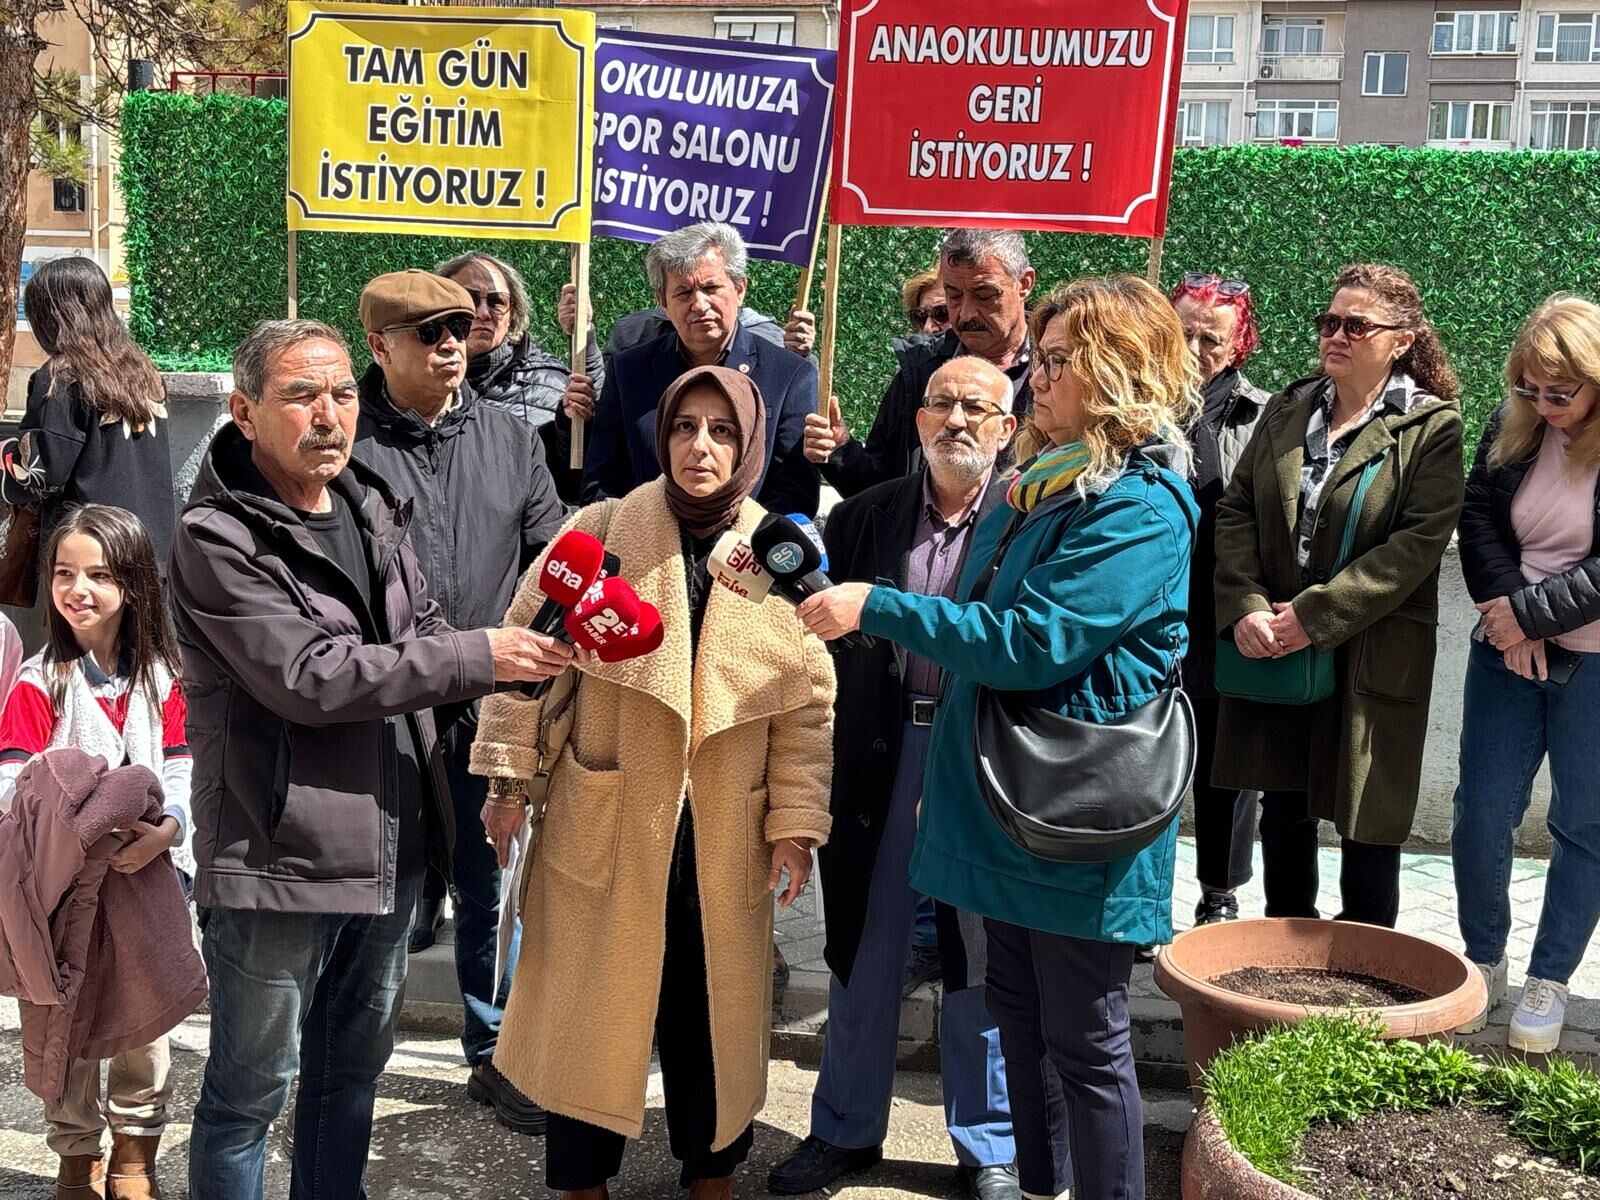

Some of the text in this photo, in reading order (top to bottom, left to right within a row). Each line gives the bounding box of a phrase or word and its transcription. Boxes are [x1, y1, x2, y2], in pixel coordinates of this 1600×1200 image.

[344, 39, 528, 89] TAM GÜN
[868, 25, 1154, 67] ANAOKULUMUZU
[600, 59, 799, 116] OKULUMUZA
[968, 76, 1042, 123] GERİ
[369, 96, 501, 147] EĞİTİM
[669, 121, 801, 173] SALONU
[321, 151, 545, 208] İSTİYORUZ !
[908, 130, 1092, 181] İSTİYORUZ !
[594, 157, 773, 227] İSTİYORUZ !
[547, 559, 583, 590] eha
[581, 621, 607, 645] HABER
